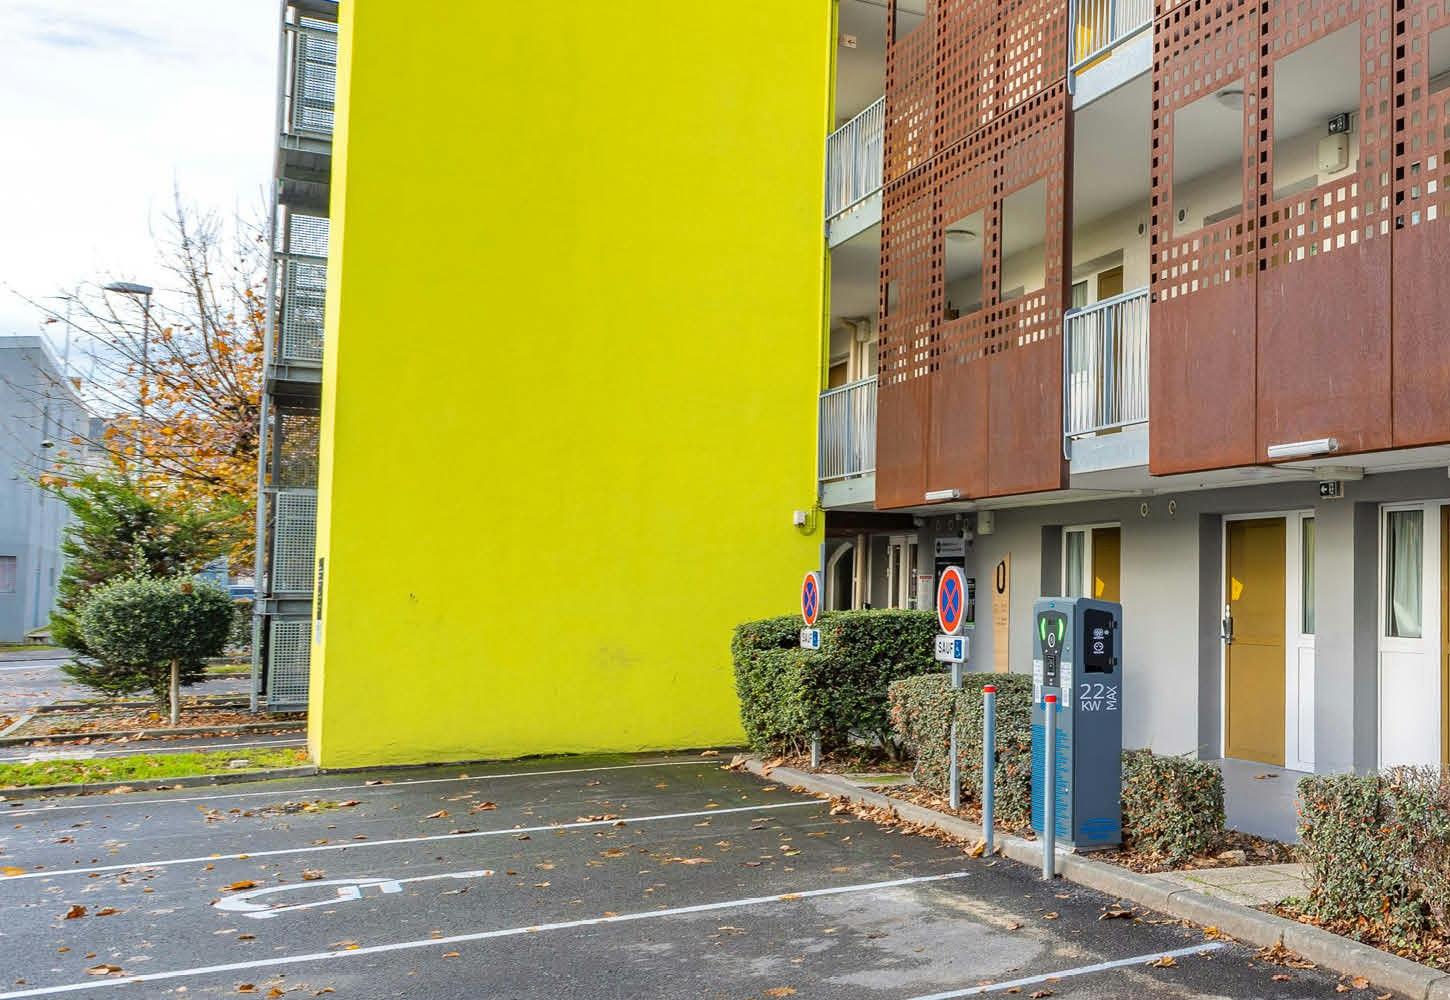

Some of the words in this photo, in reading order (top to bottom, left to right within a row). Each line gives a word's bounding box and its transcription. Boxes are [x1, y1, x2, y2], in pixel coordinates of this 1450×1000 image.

[1079, 683, 1105, 700] 22
[1106, 686, 1117, 710] MAX
[1081, 700, 1101, 711] KW
